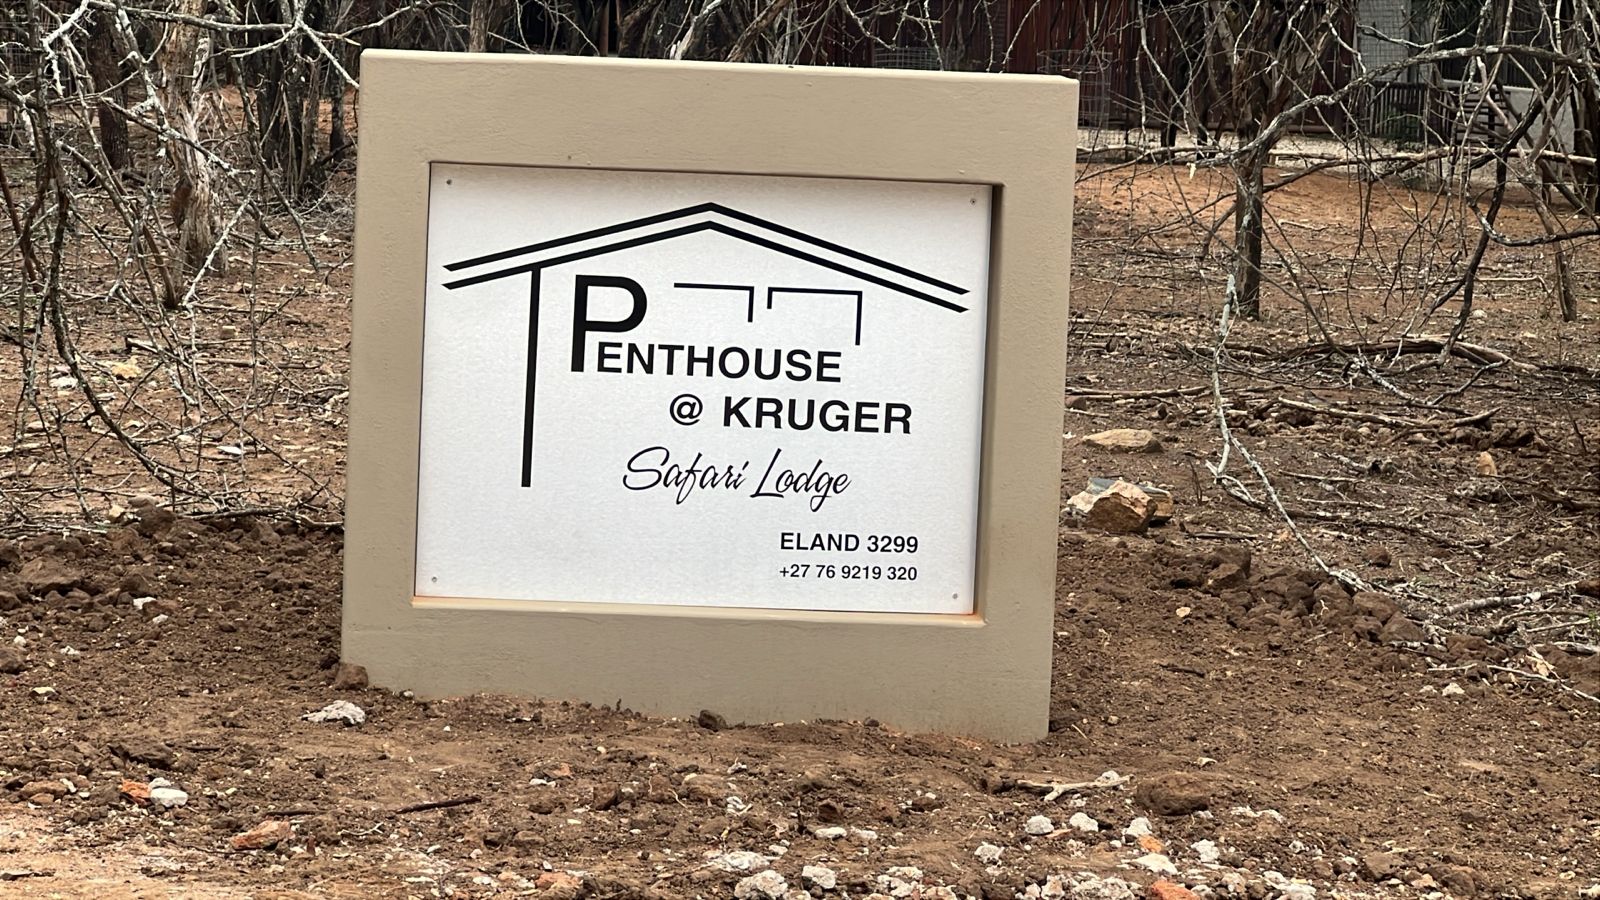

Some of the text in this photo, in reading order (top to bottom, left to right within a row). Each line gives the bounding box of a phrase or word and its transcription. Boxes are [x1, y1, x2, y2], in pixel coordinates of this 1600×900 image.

[571, 274, 842, 383] PENTHOUSE
[669, 393, 912, 434] @ KRUGER
[622, 446, 851, 513] Safari Lodge
[780, 532, 919, 554] ELAND 3299
[779, 564, 918, 581] +27 76 9219 320
